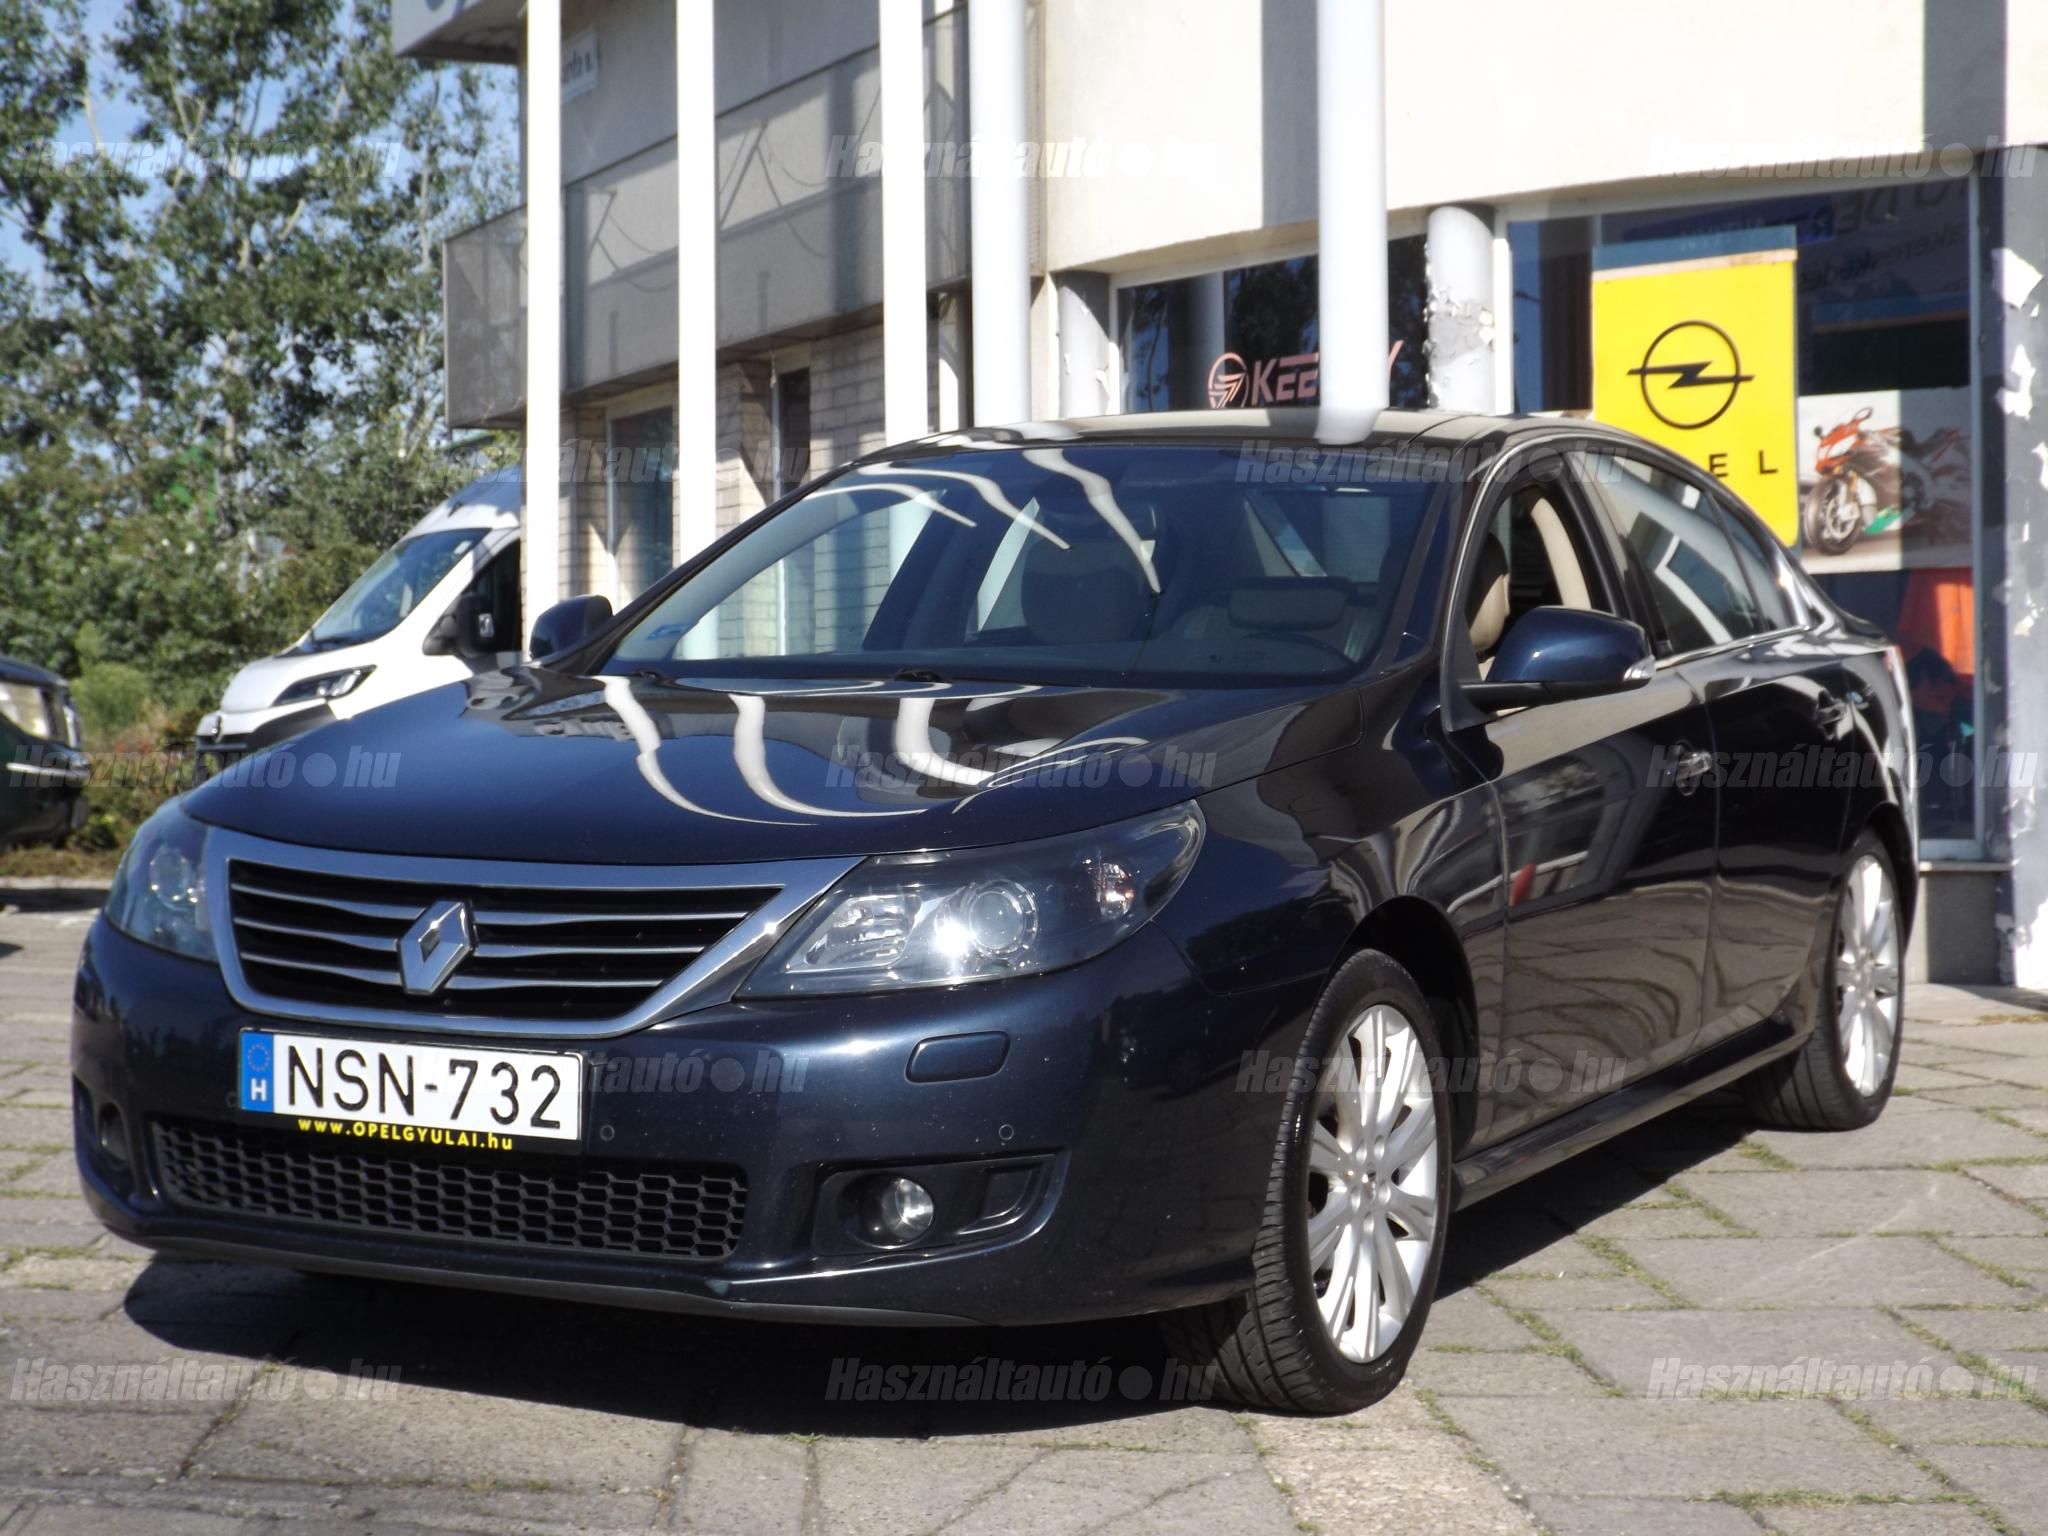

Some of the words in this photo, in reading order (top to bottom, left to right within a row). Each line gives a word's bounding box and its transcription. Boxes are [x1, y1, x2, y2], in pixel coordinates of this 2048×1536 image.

[251, 1079, 267, 1102] H
[288, 1045, 561, 1130] NSN-732
[297, 1119, 513, 1151] www.OPELGYULAI.hu
